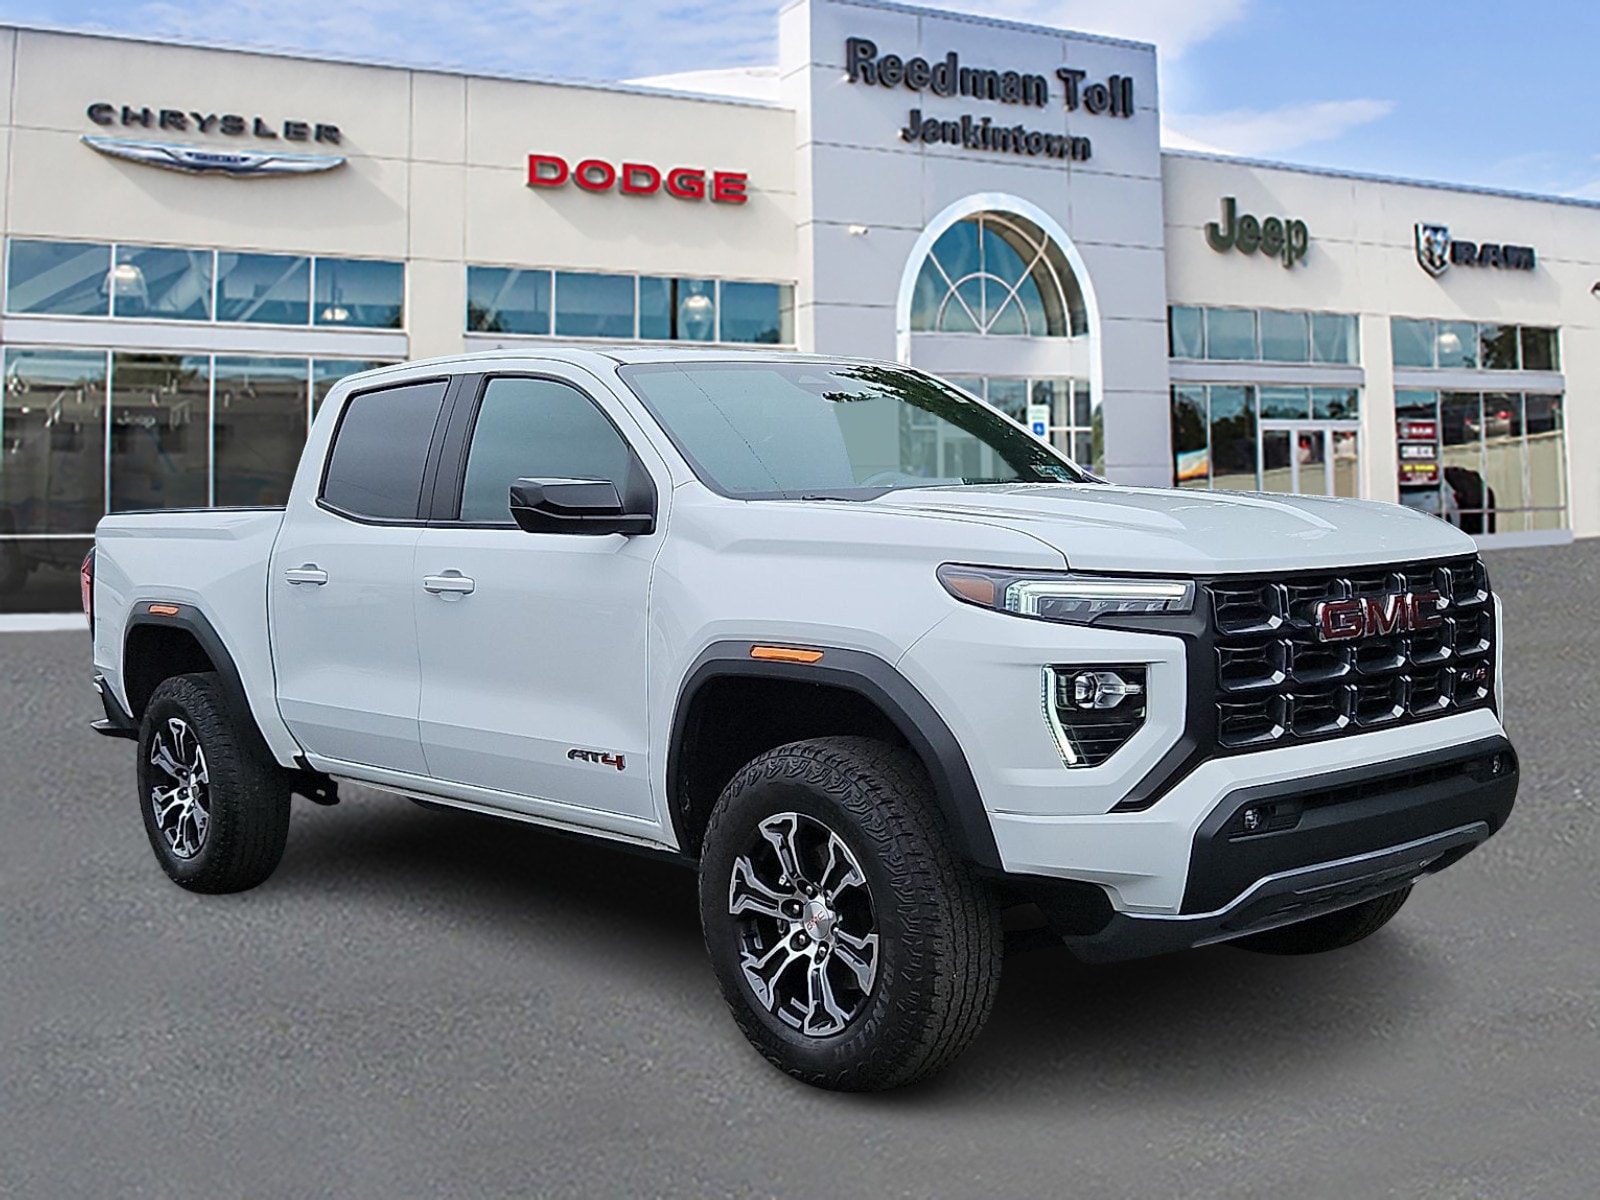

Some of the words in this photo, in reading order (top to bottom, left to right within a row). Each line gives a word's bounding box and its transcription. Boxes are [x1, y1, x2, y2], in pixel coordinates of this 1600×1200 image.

[846, 37, 1049, 108] Reedman
[1057, 67, 1134, 118] Toll
[86, 103, 341, 144] CHRYSLER
[901, 108, 1092, 161] Jenkintown
[527, 154, 749, 205] DODGE
[1204, 196, 1309, 270] Jeep
[1451, 240, 1536, 271] RAM
[1315, 590, 1442, 642] GMC
[567, 748, 626, 771] AT4
[806, 910, 825, 931] GMC
